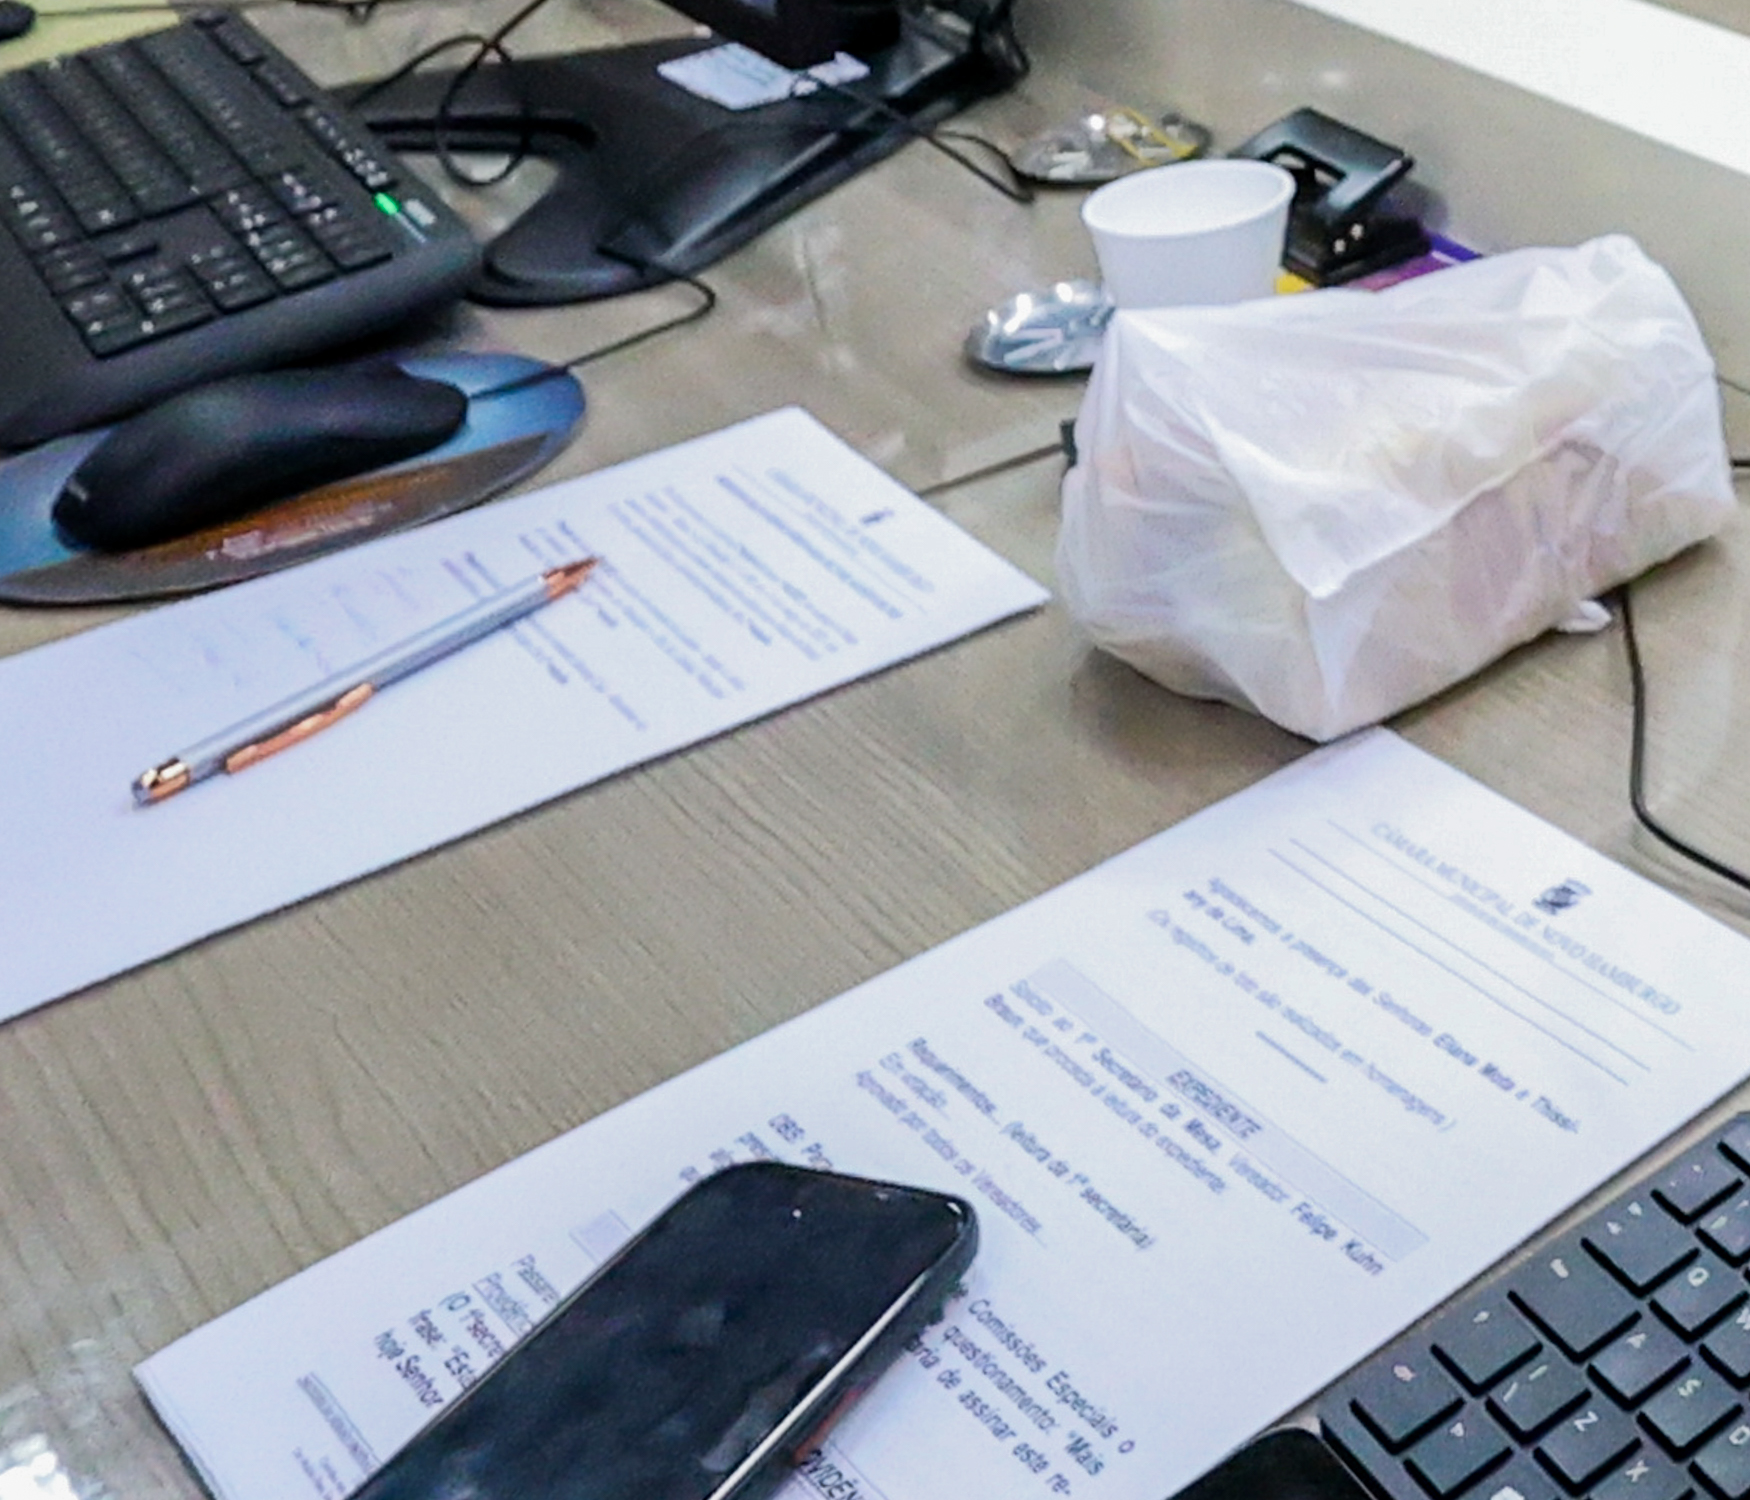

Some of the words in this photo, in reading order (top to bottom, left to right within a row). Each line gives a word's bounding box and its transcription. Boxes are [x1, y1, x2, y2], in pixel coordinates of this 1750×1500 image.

[1166, 1068, 1263, 1140] EXPEDIENTE
[1291, 1201, 1338, 1242] Felipe
[1341, 1238, 1386, 1276] Kuhn
[1688, 1268, 1711, 1289] Q
[1626, 1331, 1649, 1349] A
[395, 1353, 445, 1409] Senhor
[967, 1298, 1048, 1374] Comissões
[1045, 1370, 1119, 1439] Especiais
[1118, 1439, 1136, 1454] o
[1677, 1377, 1702, 1399] S
[936, 1368, 963, 1390] de
[957, 1389, 1018, 1442] assinar
[1011, 1442, 1050, 1474] este
[1573, 1410, 1600, 1433] Z
